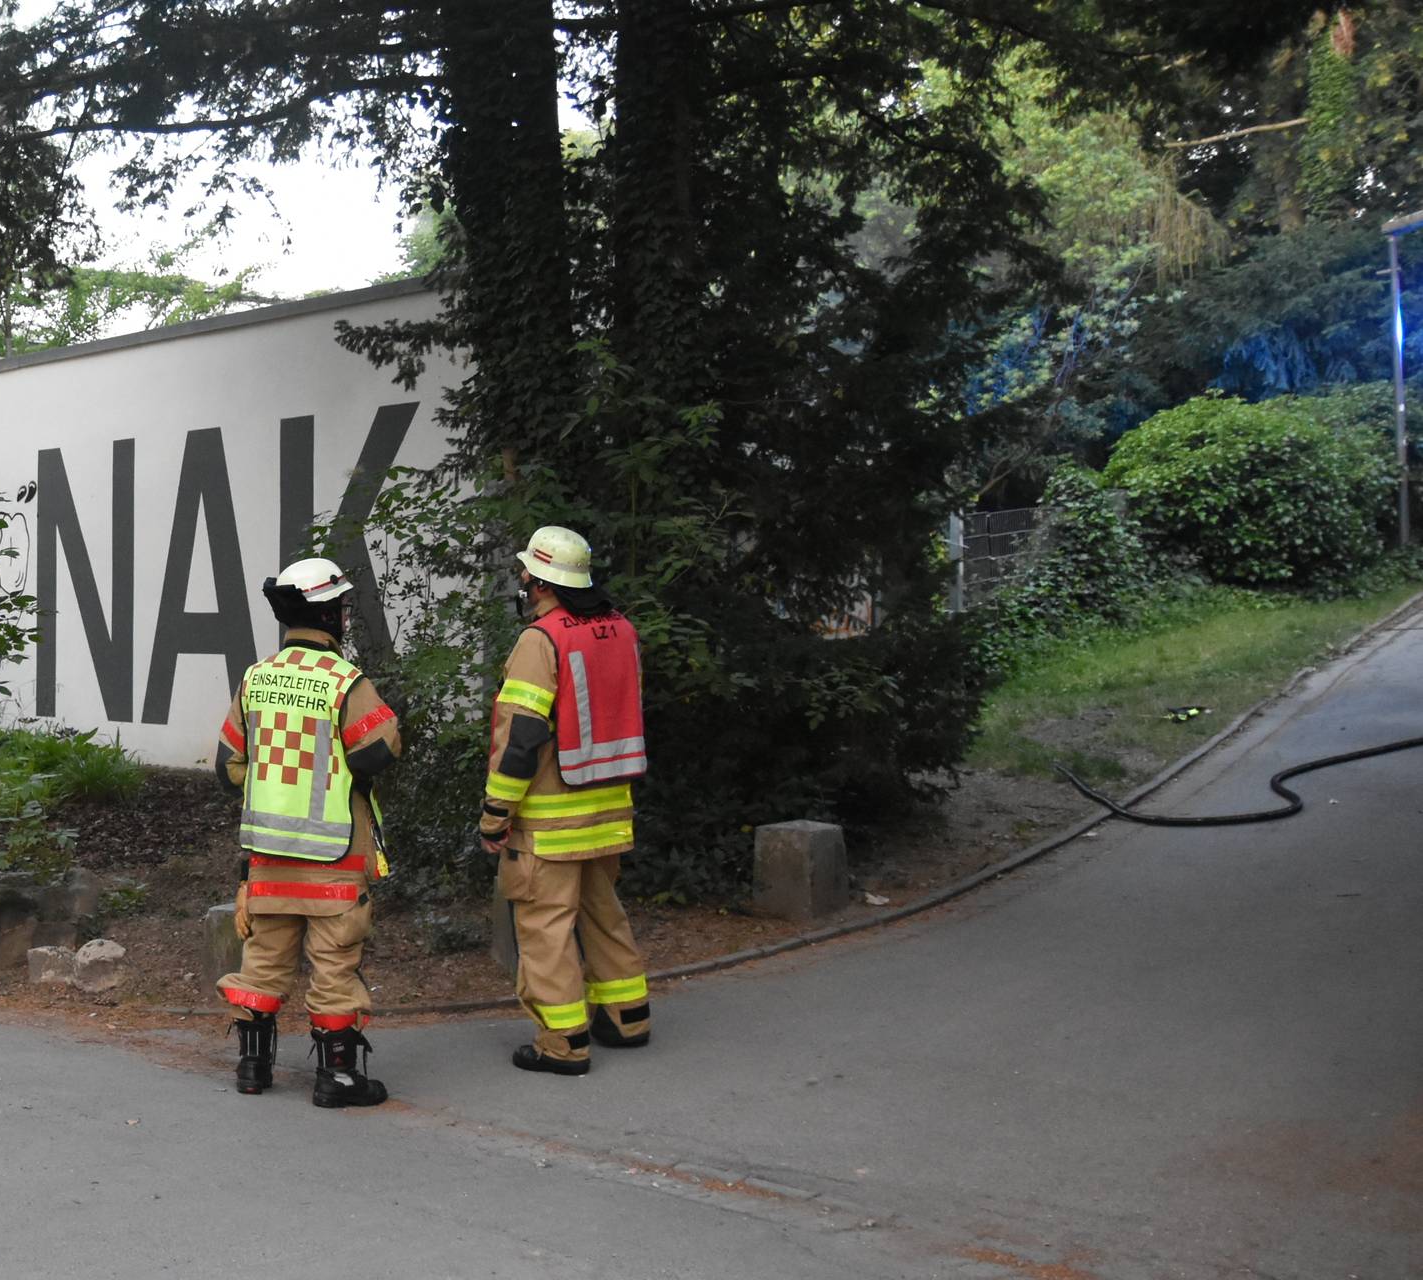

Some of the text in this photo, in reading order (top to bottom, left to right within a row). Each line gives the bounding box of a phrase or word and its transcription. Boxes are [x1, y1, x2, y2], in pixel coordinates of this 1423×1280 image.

[35, 401, 421, 726] NAK
[251, 673, 330, 695] EINSATZLEITER
[249, 690, 327, 712] FEUERWEHR
